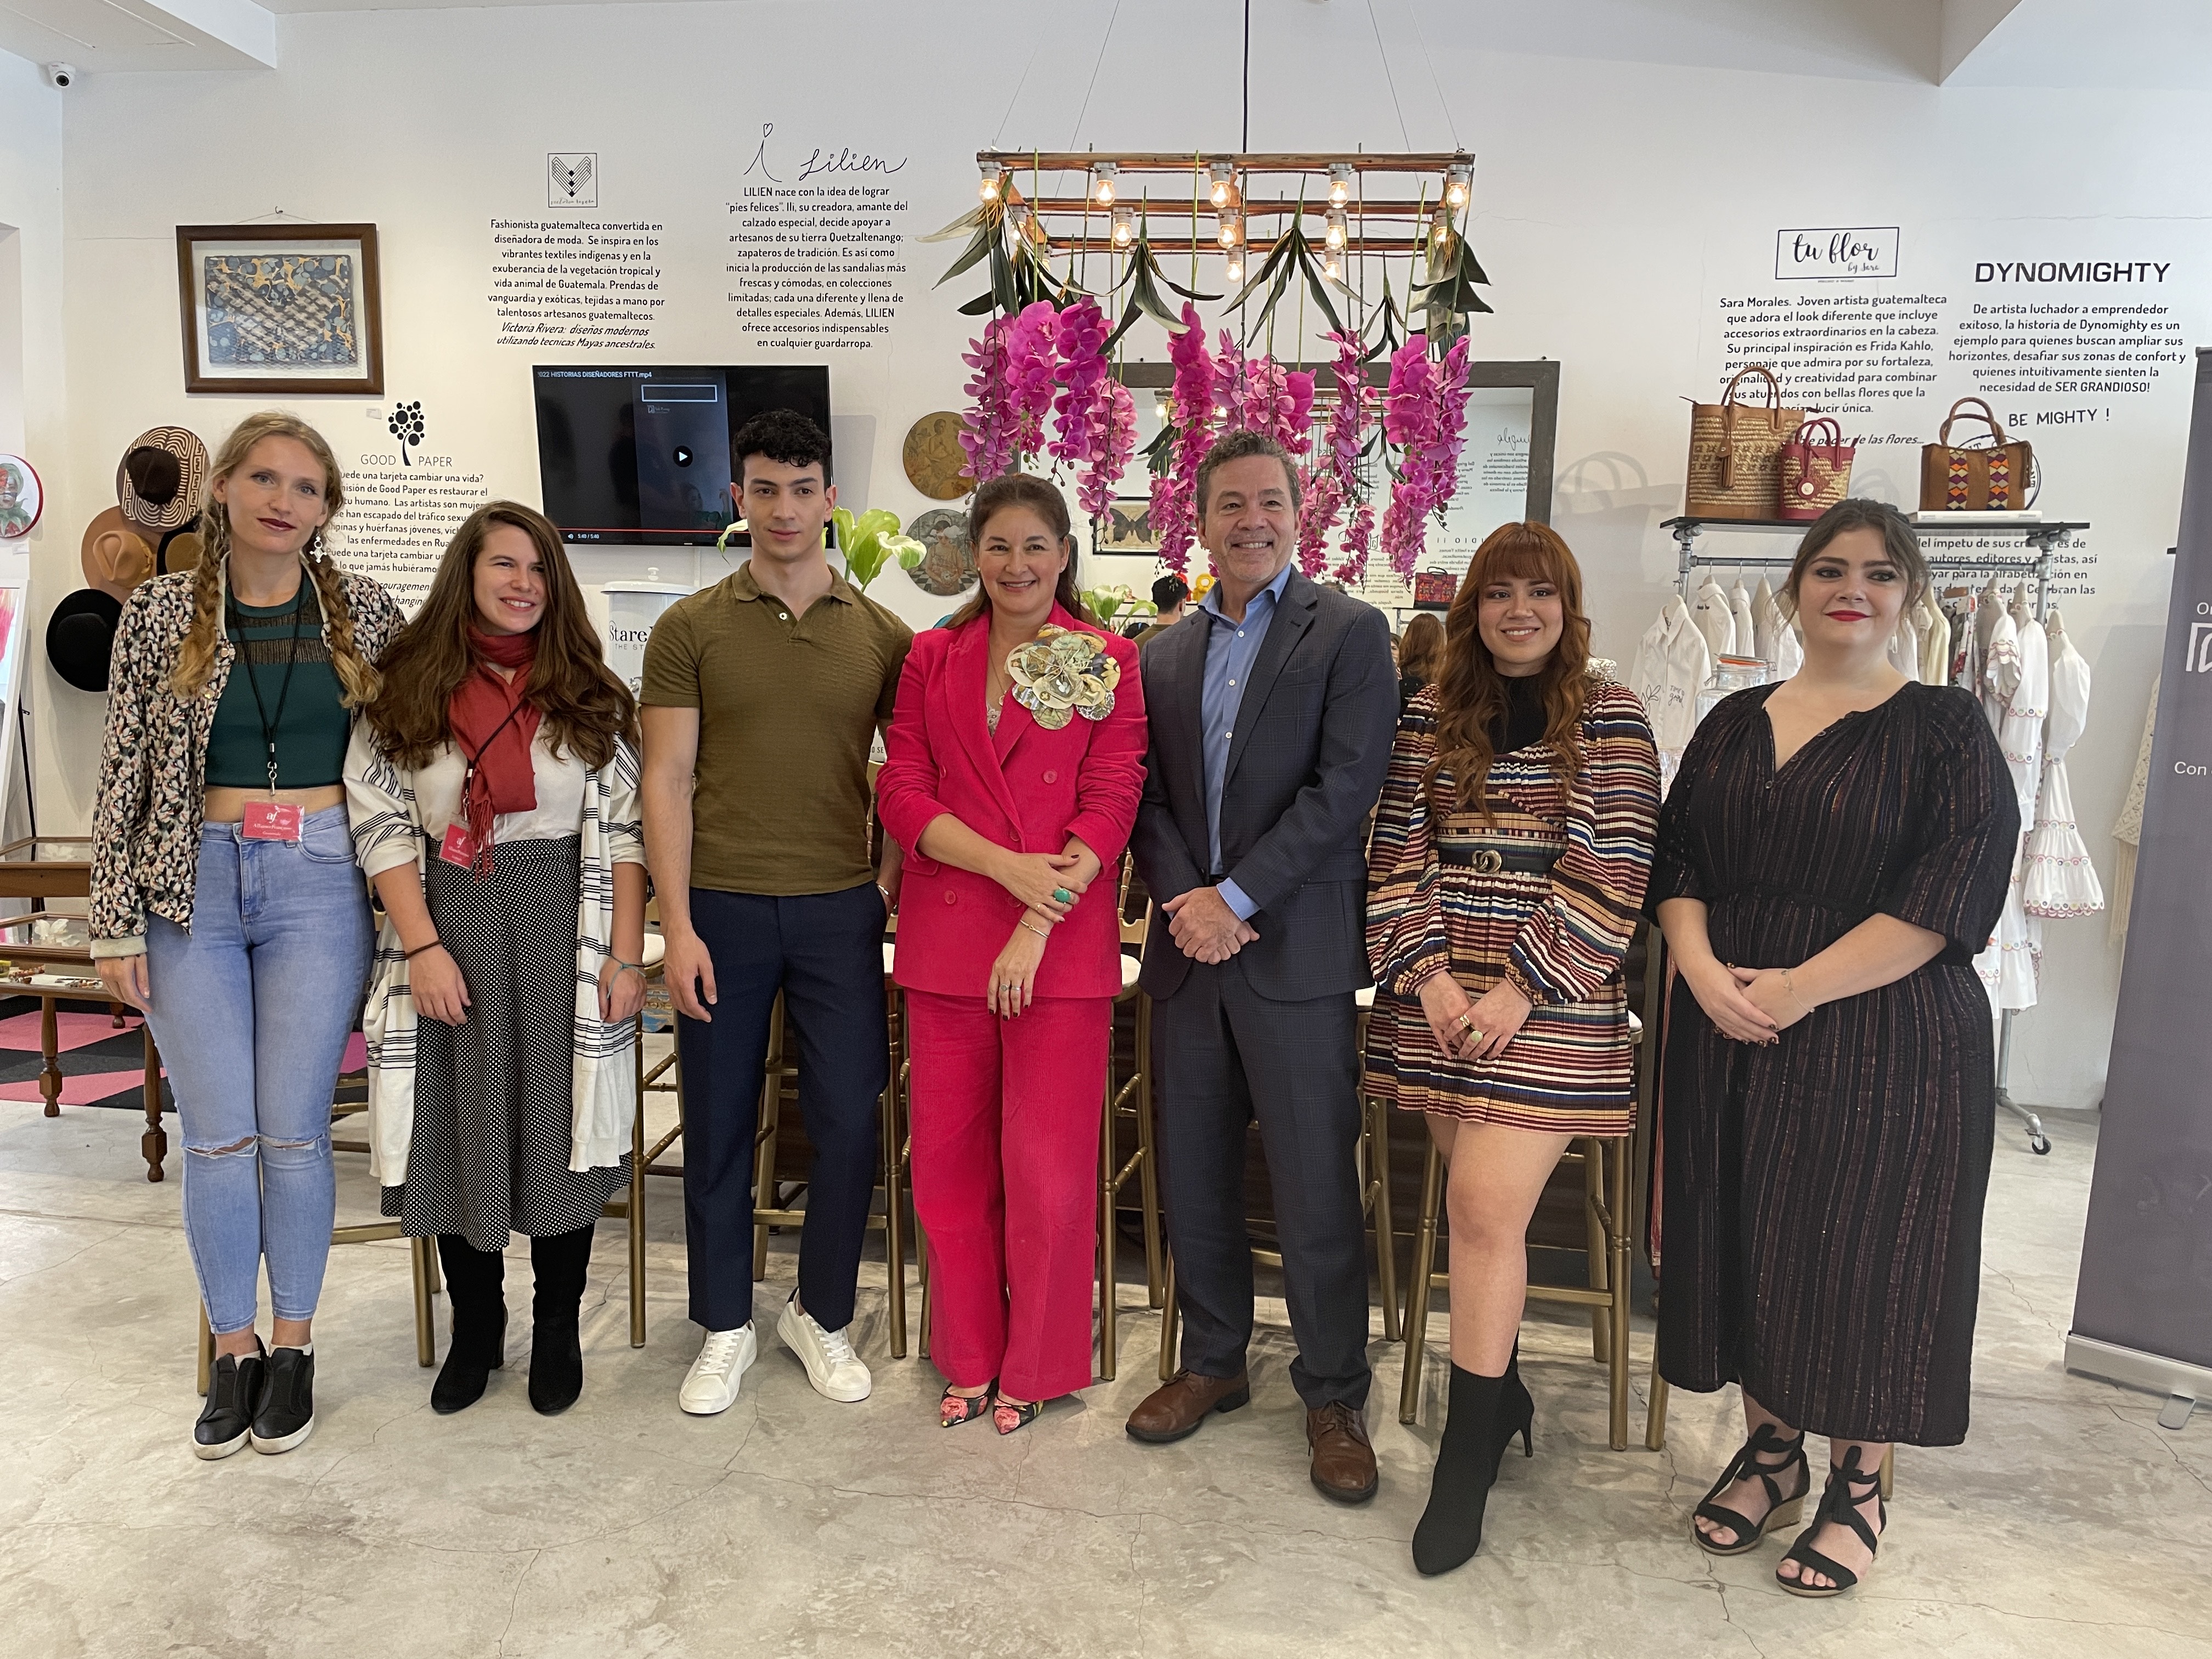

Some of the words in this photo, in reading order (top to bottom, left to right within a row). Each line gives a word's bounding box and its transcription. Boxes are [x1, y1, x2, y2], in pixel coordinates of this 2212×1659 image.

[799, 147, 907, 181] Lilien
[744, 187, 772, 197] LILIEN
[817, 186, 825, 196] la
[827, 186, 847, 196] idea
[848, 185, 860, 196] de
[862, 185, 890, 199] lograr
[490, 219, 539, 229] Fashionista
[540, 219, 600, 232] guatemalteca
[602, 221, 650, 231] convertida
[742, 217, 776, 227] calzado
[778, 216, 817, 229] especial,
[819, 216, 850, 227] decide
[851, 219, 884, 229] apoyar
[729, 233, 774, 242] artesanos
[775, 232, 787, 242] de
[802, 233, 827, 242] tierra
[830, 232, 904, 244] Quetzaltenango;
[1792, 233, 1823, 263] tu
[1829, 232, 1878, 264] flor
[501, 249, 543, 259] vibrantes
[544, 249, 577, 259] textiles
[579, 250, 621, 262] indígenas
[622, 253, 628, 263] y
[643, 251, 651, 261] la
[492, 263, 545, 274] exuberancia
[547, 264, 558, 274] de
[560, 264, 568, 274] la
[569, 265, 617, 277] vegetación
[619, 266, 654, 278] tropical
[654, 269, 661, 278] y
[1848, 262, 1858, 274] by
[1861, 262, 1880, 272] Sara
[1974, 262, 2171, 283] DYNOMIGHTY
[1719, 297, 1744, 308] Sara
[1747, 296, 1792, 307] Morales.
[1797, 295, 1831, 306] Joven
[1833, 295, 1869, 306] artista
[1871, 293, 1947, 308] guatemalteca
[497, 307, 542, 318] talentosos
[543, 309, 587, 319] artesanos
[588, 310, 655, 321] guatemaltecos.
[736, 307, 772, 317] detalles
[774, 307, 822, 320] especiales.
[824, 307, 864, 318] Además,
[866, 308, 894, 318] LILIEN
[1973, 303, 1988, 314] De
[1990, 304, 2027, 314] artista
[2030, 303, 2080, 314] luchador
[2091, 303, 2169, 317] emprendedor
[1726, 315, 1747, 326] que
[1749, 312, 1781, 323] adora
[1783, 311, 1793, 322] el
[1796, 311, 1819, 321] look
[1821, 310, 1872, 321] diferente
[1875, 313, 1896, 323] que
[1898, 309, 1938, 323] incluye
[501, 321, 535, 333] Victoria
[535, 323, 567, 334] Rivera:
[569, 323, 604, 335] diseños
[603, 325, 650, 336] modernos
[742, 322, 771, 332] ofrece
[772, 323, 820, 332] accesorios
[822, 323, 889, 335] indispensables
[1723, 328, 1780, 338] accesorios
[1782, 326, 1867, 337] extraordinarios
[1886, 325, 1895, 336] la
[1898, 324, 1939, 336] cabeza.
[496, 335, 539, 346] utilizando
[540, 337, 576, 347] tecnicas
[575, 337, 605, 349] Mayas
[604, 339, 656, 349] ancestrales.
[770, 337, 813, 350] cualquier
[814, 337, 873, 351] guardarropa.
[1726, 343, 1741, 354] Su
[1743, 342, 1791, 356] principal
[1793, 341, 1853, 355] inspiración
[1870, 340, 1897, 351] Frida
[1900, 340, 1934, 352] Kahlo,
[1953, 334, 1999, 348] ejemplo
[2001, 338, 2027, 348] para
[2029, 335, 2073, 348] quienes
[2076, 334, 2116, 346] buscan
[2118, 335, 2163, 348] ampliar
[2164, 338, 2183, 346] sus
[1972, 366, 2016, 379] quienes
[2019, 366, 2102, 377] intuitivamente
[2104, 366, 2147, 377] sienten
[2149, 366, 2159, 377] la
[1979, 381, 2036, 392] necesidad
[2038, 381, 2052, 392] de
[2055, 381, 2078, 392] SER
[2080, 381, 2150, 393] GRANDIOSO!
[1816, 403, 1840, 414] lucir
[1842, 403, 1874, 414] única.
[2008, 413, 2028, 427] BE
[2036, 408, 2098, 425] MIGHTY
[2106, 408, 2109, 422] !
[1868, 433, 1883, 444] las
[360, 454, 397, 466] GOOD
[418, 455, 453, 467] PAPER
[341, 470, 360, 479] uede
[380, 471, 408, 483] tarjeta
[409, 472, 443, 482] cambiar
[462, 473, 484, 483] vida?
[366, 483, 377, 493] de
[379, 484, 400, 493] Good
[402, 484, 427, 496] Paper
[439, 487, 479, 496] restaurar
[480, 487, 488, 496] el
[355, 496, 390, 506] humano.
[394, 498, 409, 507] Las
[410, 499, 442, 508] artistas
[459, 500, 484, 511] muje
[347, 535, 359, 544] las
[360, 535, 421, 546] enfermedades
[1933, 538, 1973, 551] ímpetu
[1976, 538, 1989, 548] de
[1992, 540, 2011, 549] sus
[609, 620, 653, 642] Stare
[2174, 761, 2207, 776] Con
